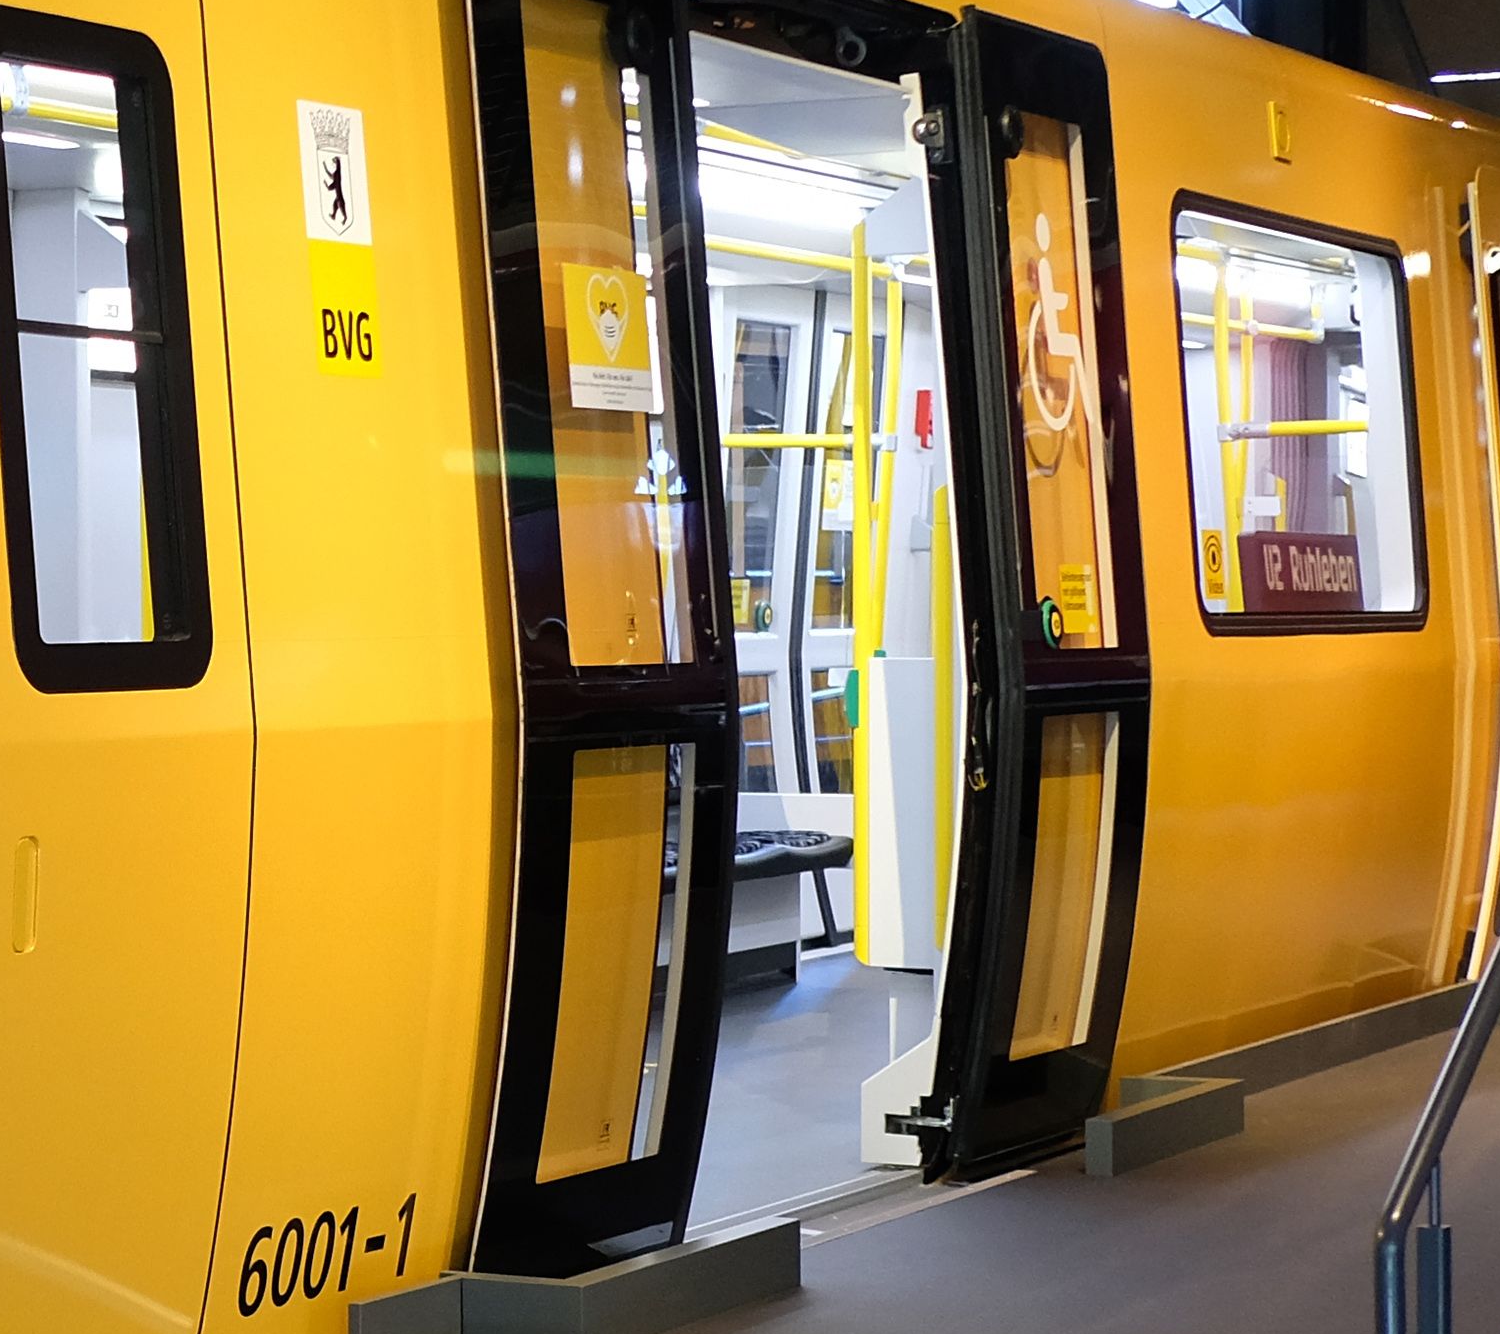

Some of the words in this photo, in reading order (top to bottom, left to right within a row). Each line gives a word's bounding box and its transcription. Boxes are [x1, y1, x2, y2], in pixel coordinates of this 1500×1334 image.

[321, 308, 373, 362] BVG
[1262, 543, 1285, 591] U2
[1288, 545, 1358, 593] Ruhleben
[237, 1191, 418, 1318] 6001-1
